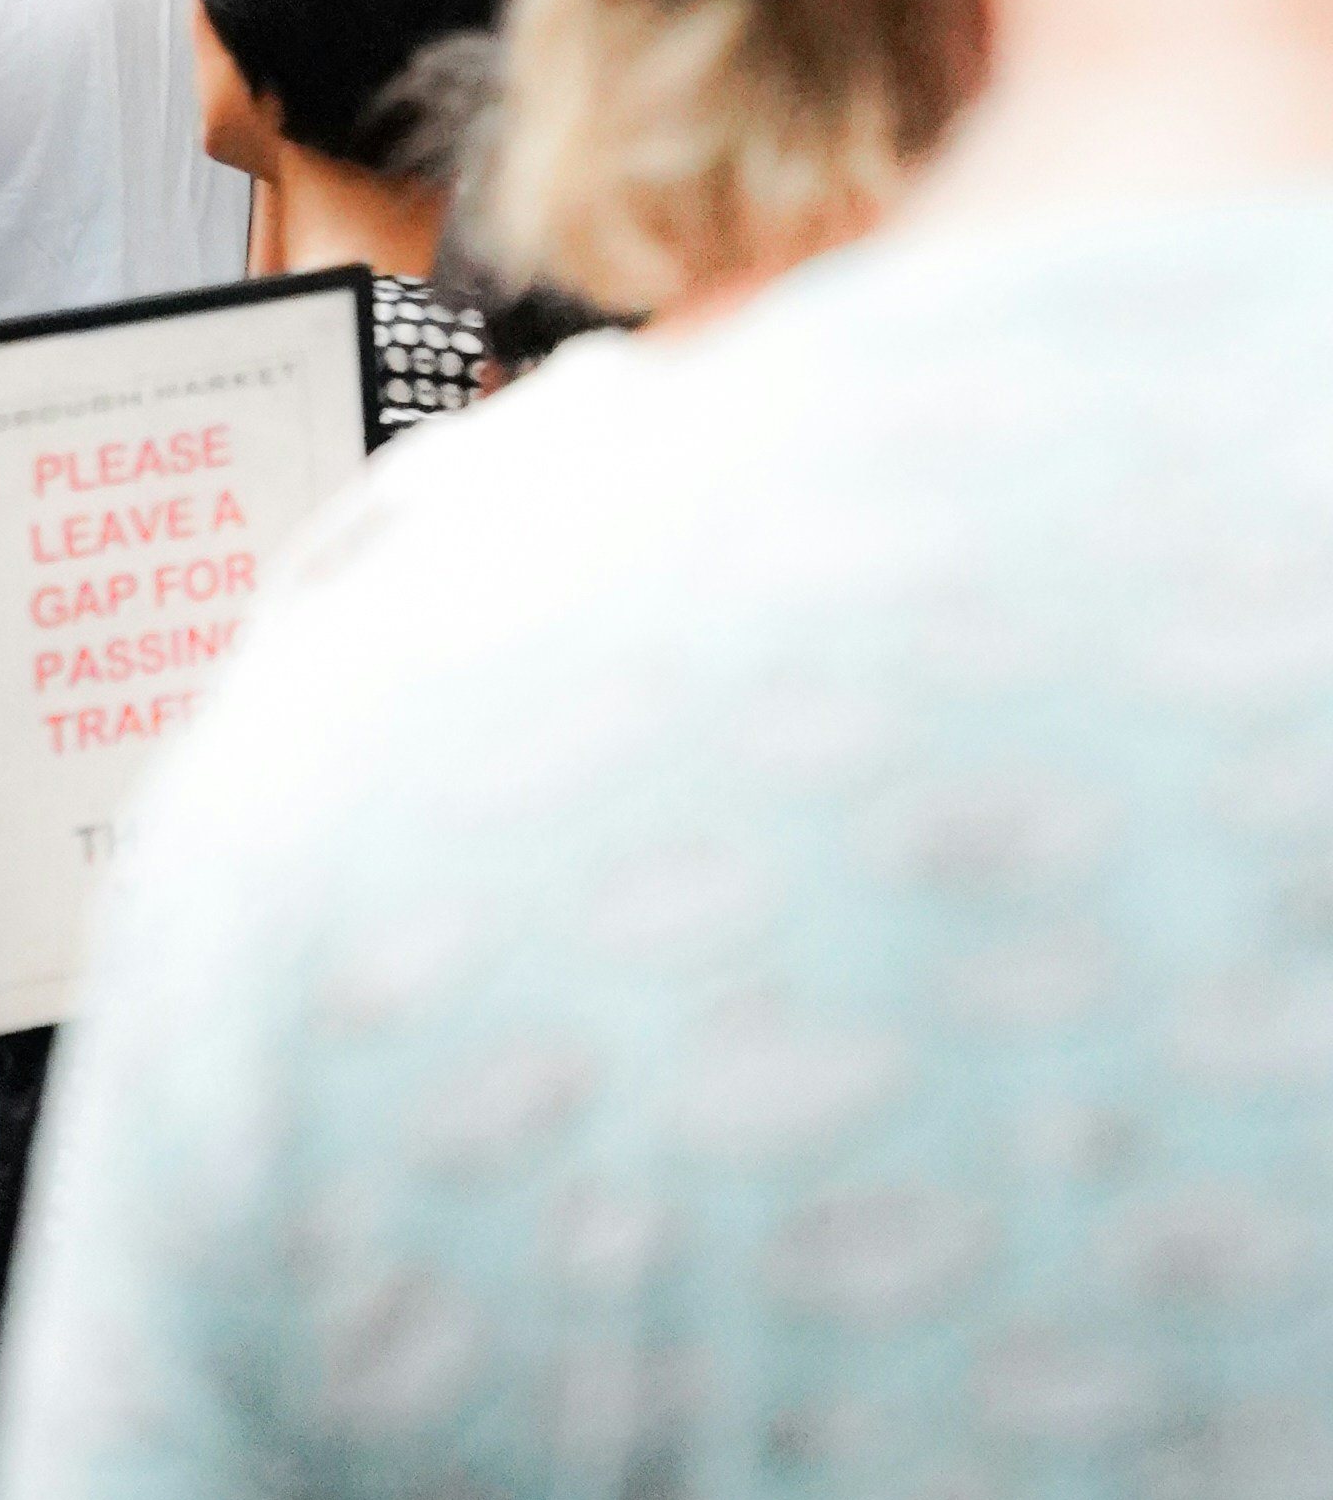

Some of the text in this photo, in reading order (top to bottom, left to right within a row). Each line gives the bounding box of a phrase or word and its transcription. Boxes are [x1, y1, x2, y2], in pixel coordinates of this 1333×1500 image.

[32, 421, 233, 499] PLEASE
[28, 487, 247, 565] LEAVE A
[28, 551, 257, 630] GAP FOR
